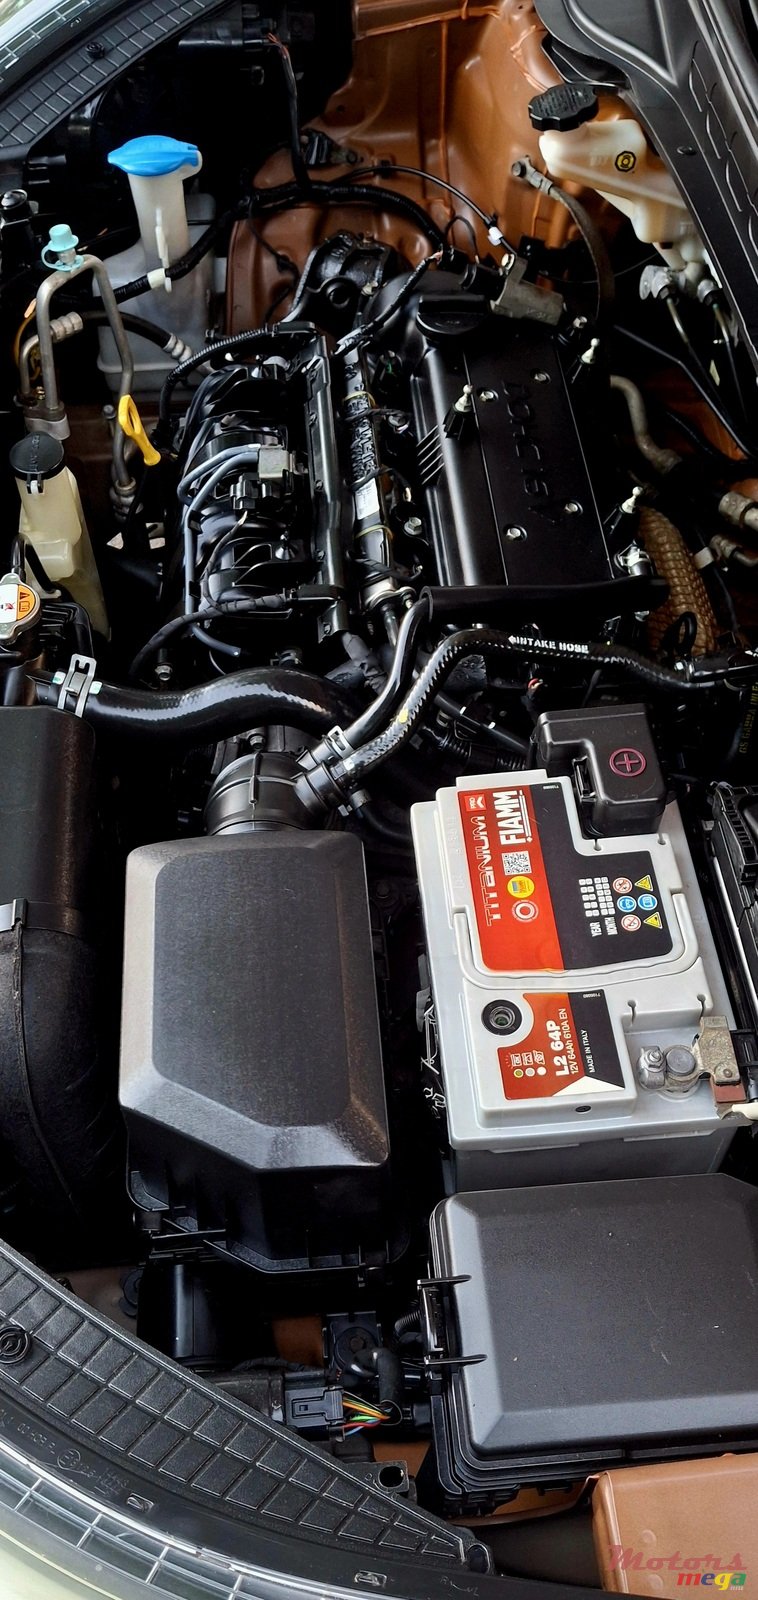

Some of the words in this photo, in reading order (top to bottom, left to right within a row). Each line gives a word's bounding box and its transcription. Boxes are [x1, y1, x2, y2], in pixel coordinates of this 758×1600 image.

[516, 636, 556, 649] INTAKE
[559, 642, 589, 654] HOSE
[468, 797, 477, 809] PRO
[492, 790, 527, 845] FIAMM
[589, 921, 602, 937] YEAR
[604, 917, 618, 935] MONTH
[558, 1008, 568, 1020] EN
[546, 1020, 564, 1051] 64P
[561, 1021, 572, 1040] 610A
[581, 1029, 590, 1046] ITALY
[565, 1040, 576, 1061] 64Ah
[583, 1046, 591, 1054] IN
[553, 1055, 570, 1076] L2
[568, 1061, 579, 1074] 12V
[584, 1055, 595, 1073] MADE
